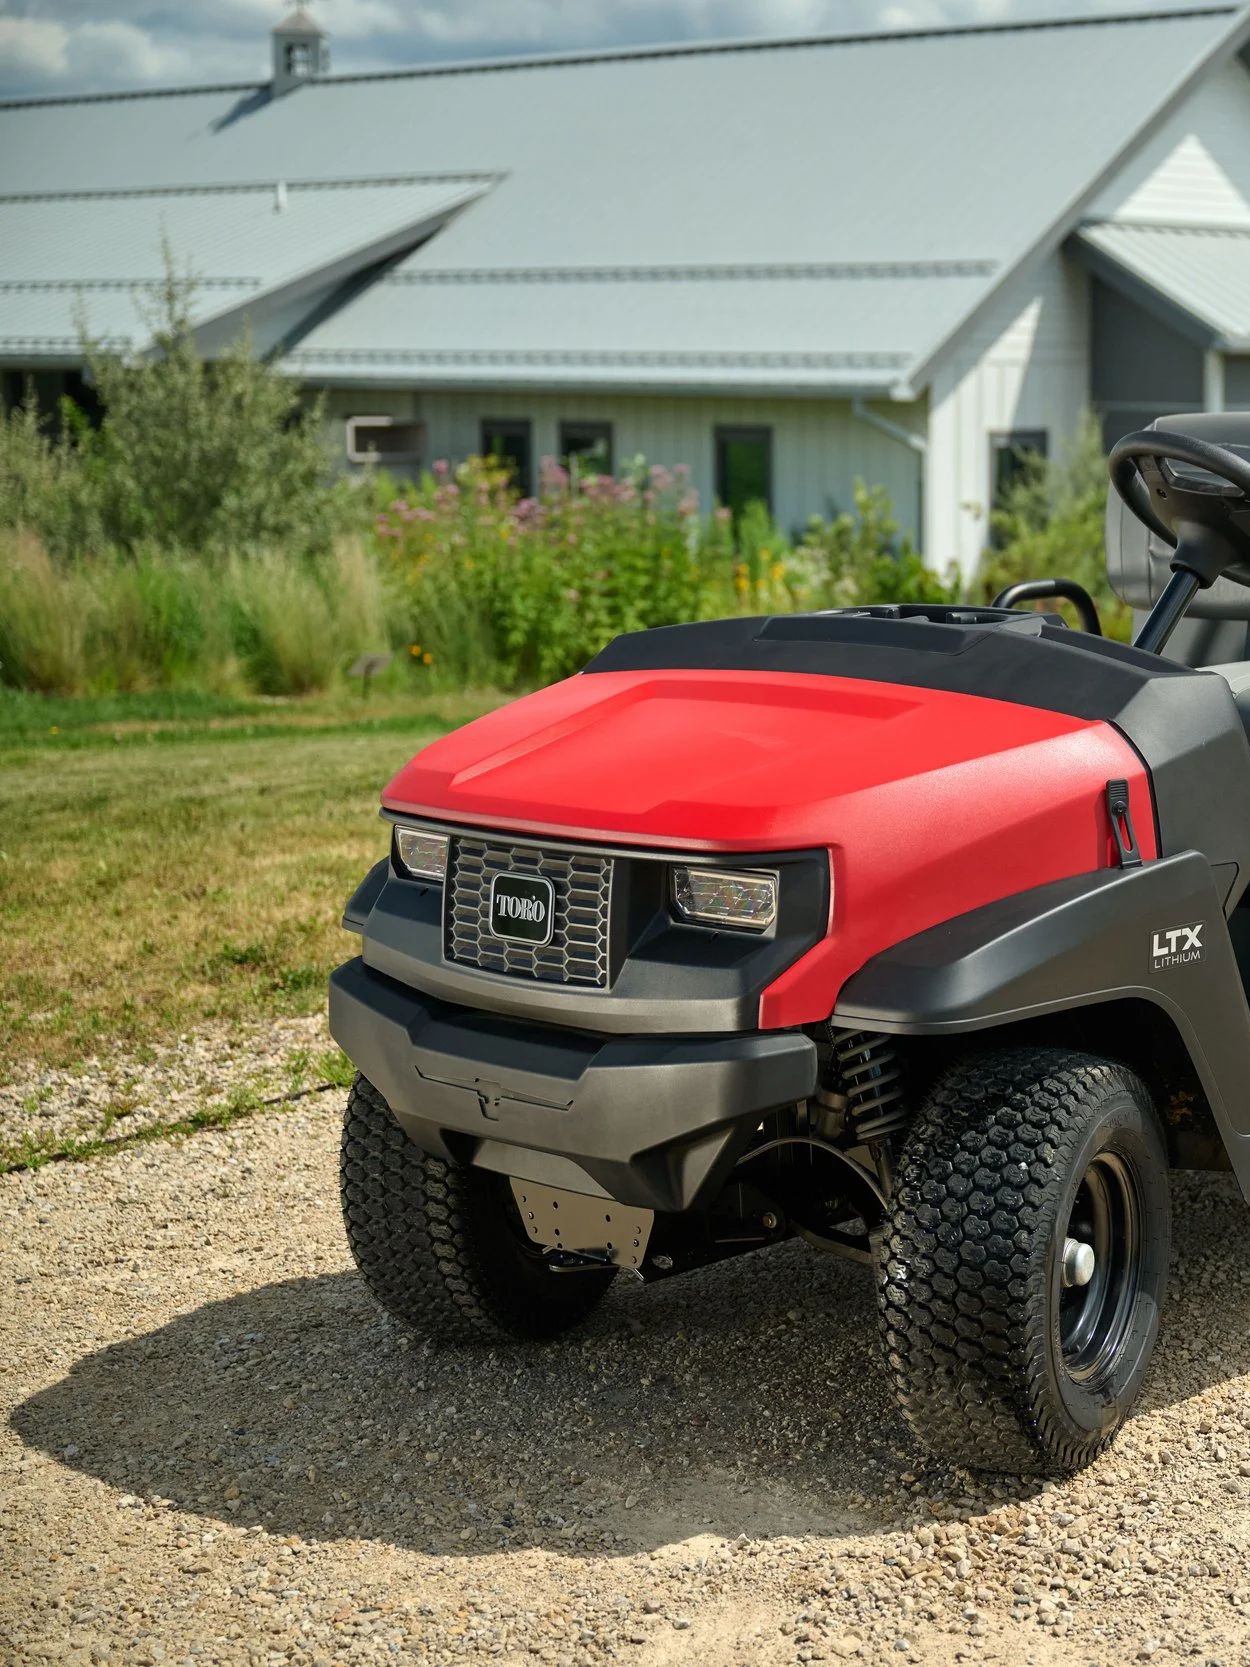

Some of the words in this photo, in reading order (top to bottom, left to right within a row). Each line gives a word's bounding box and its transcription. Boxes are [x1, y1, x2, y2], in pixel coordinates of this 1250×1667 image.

[496, 894, 545, 922] TORO
[1153, 924, 1203, 957] LTX
[1154, 950, 1200, 968] LITHIUM
